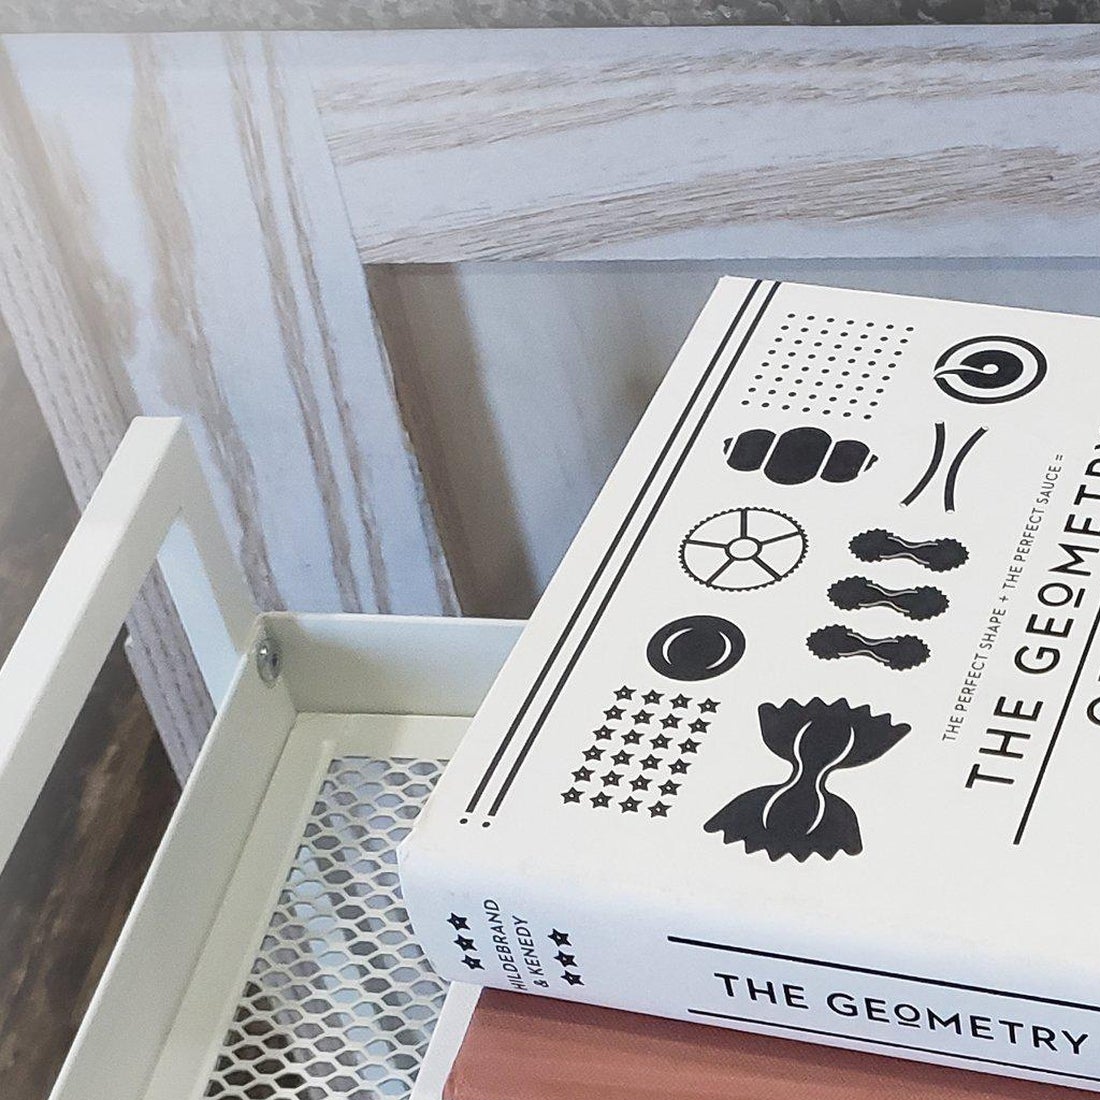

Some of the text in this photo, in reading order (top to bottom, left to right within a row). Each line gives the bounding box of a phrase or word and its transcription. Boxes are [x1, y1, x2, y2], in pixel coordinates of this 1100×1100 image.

[942, 715, 964, 741] THE
[955, 653, 988, 712] PERFECT
[979, 608, 1006, 650] SHAPE
[1002, 565, 1023, 590] THE
[1013, 507, 1045, 562] PERFECT
[1036, 465, 1062, 505] SAUCE
[965, 696, 1044, 788] THE
[483, 899, 528, 991] HILDEBRAND
[512, 915, 549, 988] & KENEDY
[714, 972, 809, 1010] THE
[826, 992, 1089, 1055] GEOMETRY
